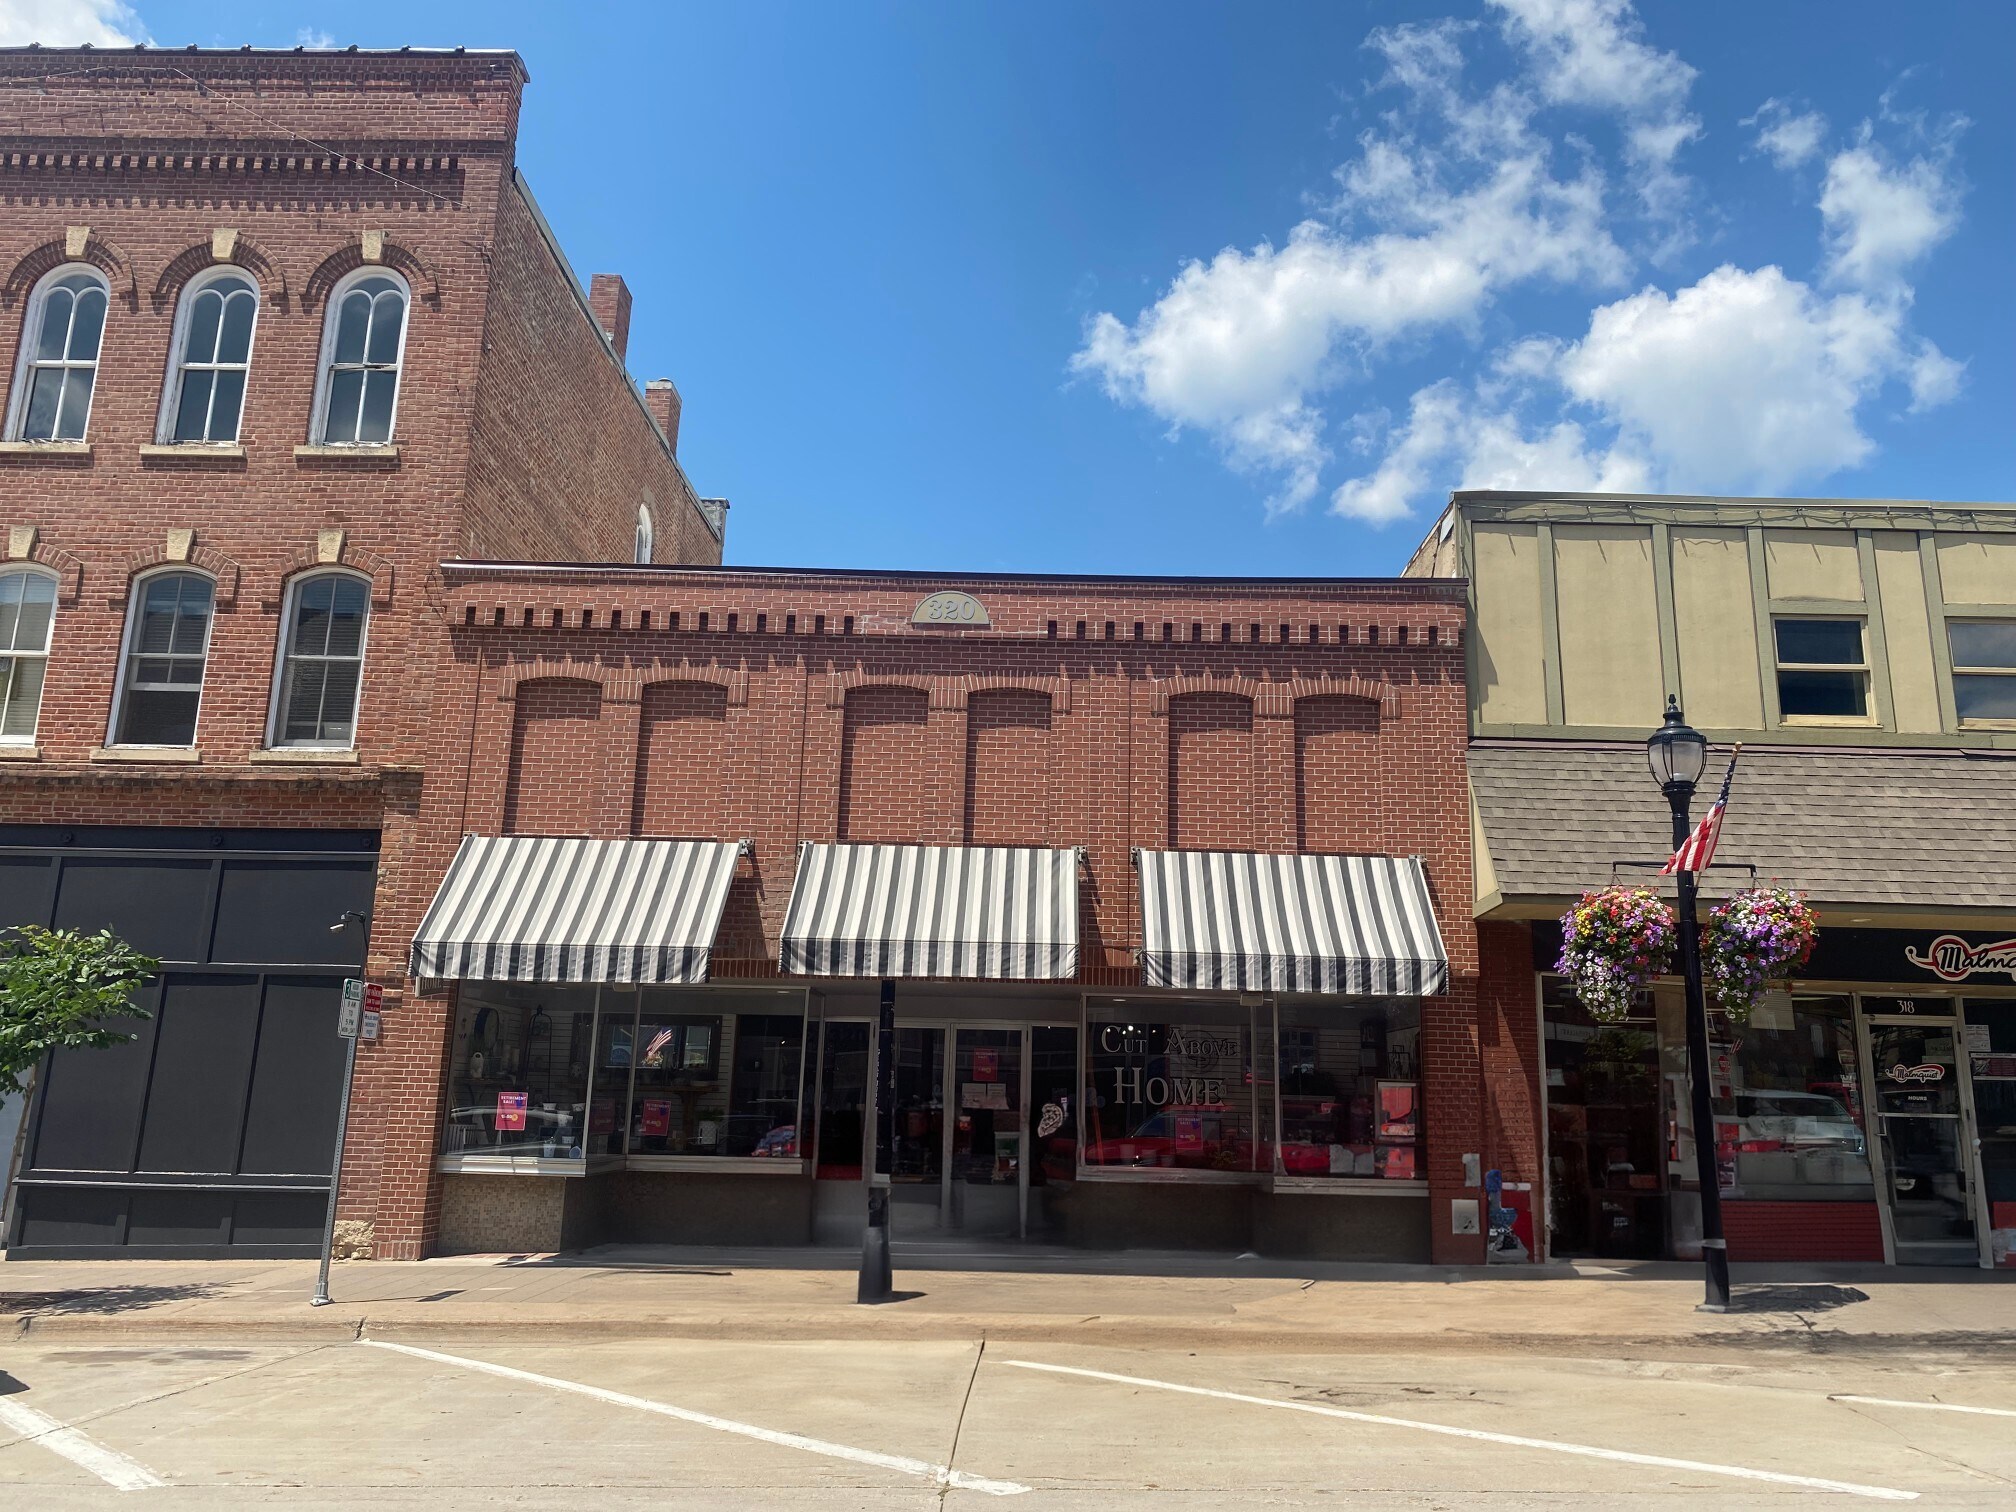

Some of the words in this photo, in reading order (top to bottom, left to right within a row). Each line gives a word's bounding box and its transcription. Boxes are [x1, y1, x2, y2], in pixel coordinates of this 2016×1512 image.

[928, 600, 976, 621] 320
[1896, 1000, 1915, 1014] 318
[1113, 1066, 1226, 1107] HOME
